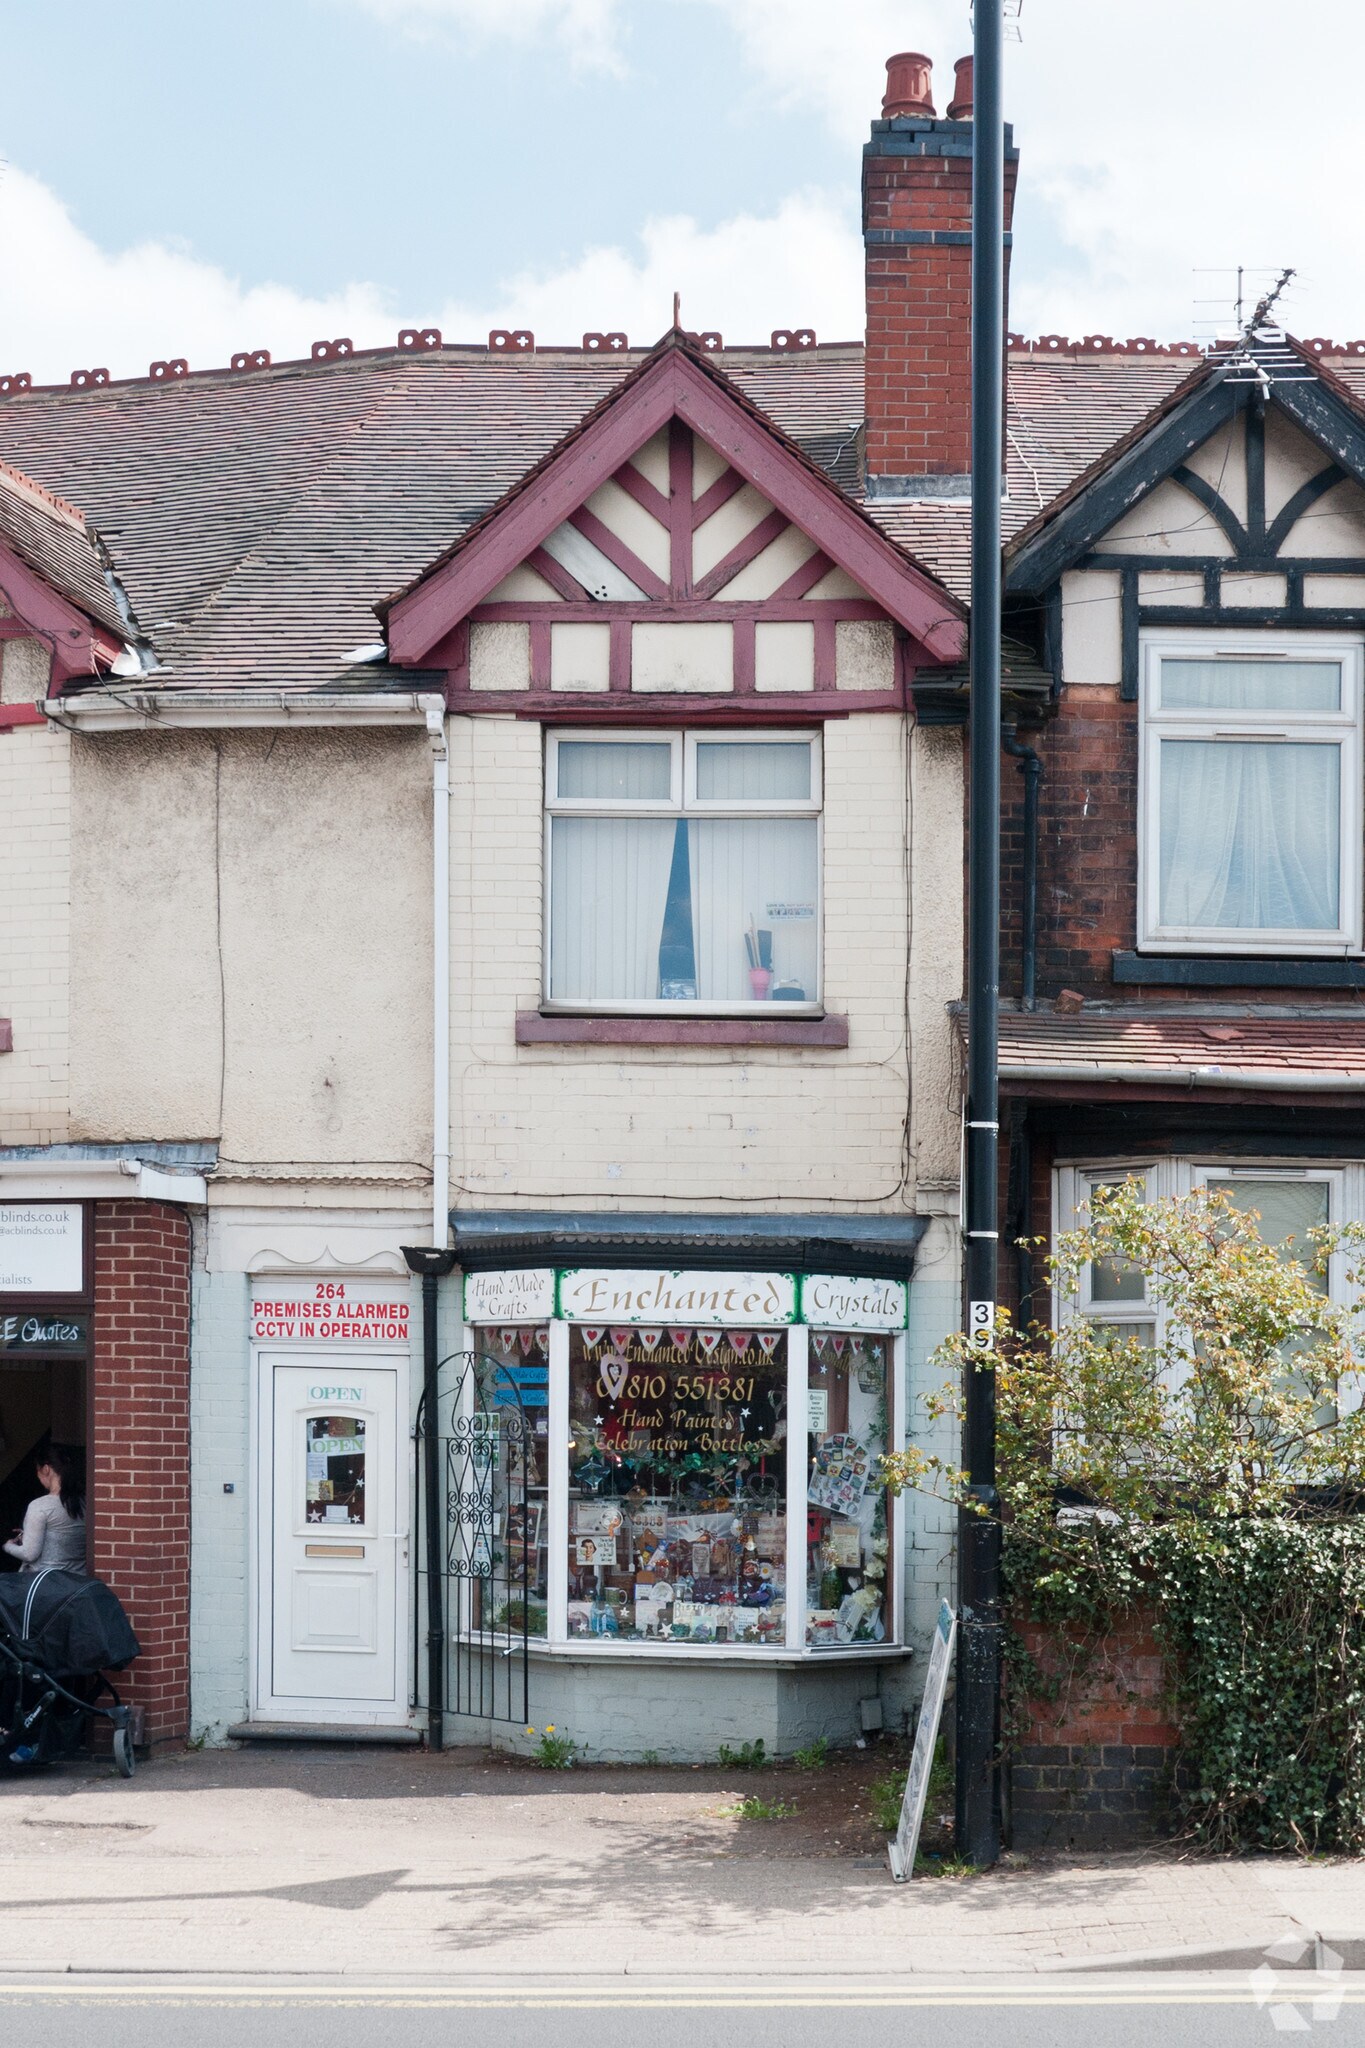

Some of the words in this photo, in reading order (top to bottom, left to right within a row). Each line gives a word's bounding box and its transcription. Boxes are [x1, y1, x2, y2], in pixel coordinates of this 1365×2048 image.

[0, 1273, 33, 1285] ialists
[472, 1276, 505, 1296] Hand
[509, 1273, 545, 1294] Made
[315, 1283, 346, 1299] 264
[573, 1275, 780, 1315] Enchanted
[813, 1282, 899, 1320] Crystals
[253, 1302, 332, 1318] PREMISES
[336, 1303, 410, 1319] ALARMED
[488, 1295, 528, 1320] Crafts
[0, 1316, 18, 1341] E
[21, 1317, 79, 1342] Quotes
[255, 1321, 295, 1337] CCTV
[300, 1322, 315, 1337] IN
[320, 1322, 409, 1339] OPERATION
[310, 1386, 363, 1401] OPEN
[674, 1375, 755, 1402] 551381
[617, 1408, 664, 1427] Hand
[670, 1408, 735, 1429] Painted
[311, 1438, 363, 1453] OPEN
[594, 1431, 688, 1452] Celebration
[694, 1432, 761, 1452] Bottles
